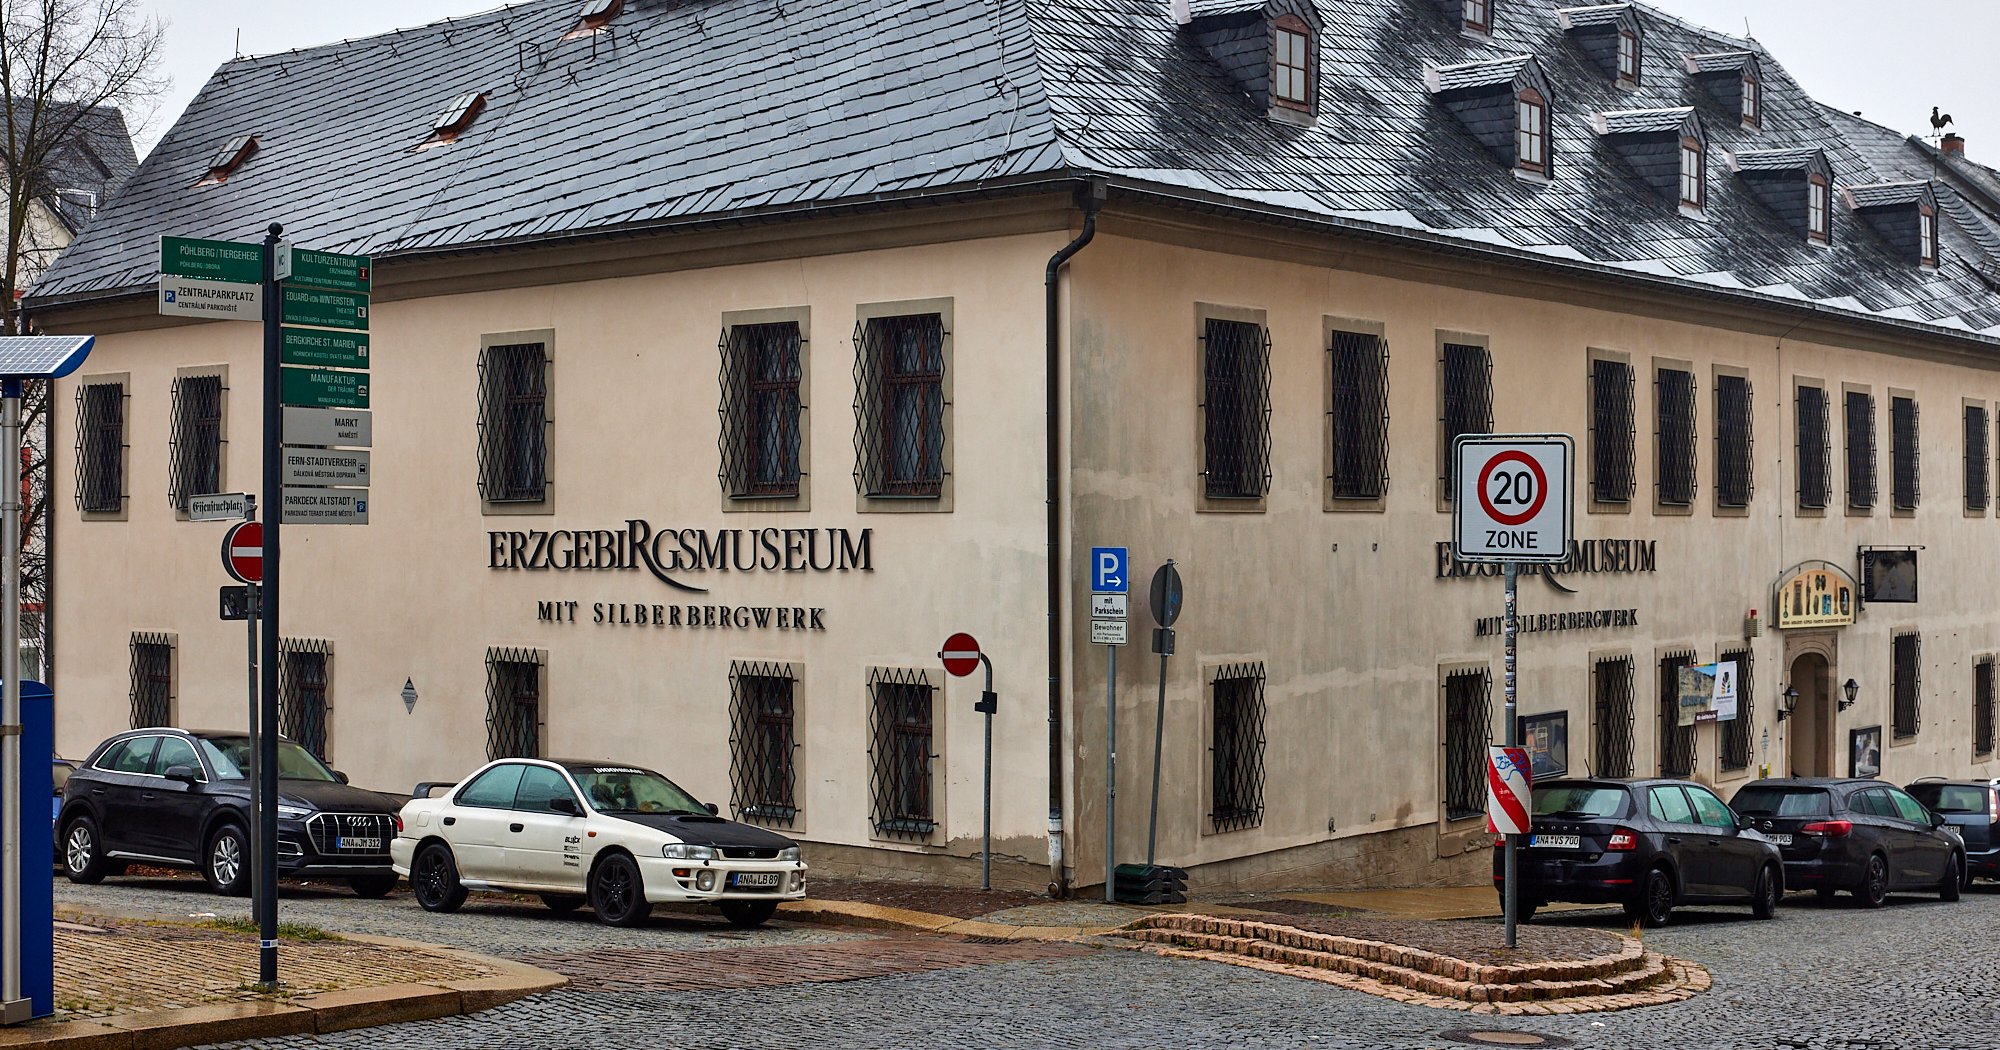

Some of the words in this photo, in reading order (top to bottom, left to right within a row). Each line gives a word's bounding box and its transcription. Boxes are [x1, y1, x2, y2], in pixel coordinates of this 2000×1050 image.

[180, 244, 215, 258] PÖHLBERG
[219, 248, 259, 260] TIERGEHEGE
[301, 254, 357, 268] KULTURZENTRUM
[178, 286, 254, 301] ZENTRALPARKPLATZ
[286, 292, 308, 302] EDUARD
[319, 296, 355, 306] WINTERSTEIN
[286, 335, 321, 346] BERGKIRCHE
[322, 338, 332, 347] ST.
[333, 339, 355, 349] MARIEN
[310, 374, 355, 385] MANUFAKTUR
[334, 418, 358, 427] MARKT
[288, 456, 357, 467] FERN-STADTVERKEHR
[1493, 471, 1532, 505] 20
[285, 496, 318, 505] PARKDECK
[320, 496, 350, 505] ALTSTADT
[1485, 531, 1538, 549] ZONE
[487, 519, 874, 592] ERZGEBIRGSMUSEUM
[1100, 553, 1119, 586] P
[537, 600, 578, 622] MIT
[593, 602, 826, 630] SILBERBERGWERK
[1095, 606, 1124, 615] Parkschein
[1476, 616, 1505, 637] MIT
[1515, 608, 1638, 633] SILBERBERGWERK
[342, 838, 354, 847] ANA
[368, 839, 380, 847] 312
[1536, 836, 1549, 844] ANA
[1554, 836, 1564, 844] VS
[1565, 837, 1578, 845] 700
[1779, 835, 1792, 843] 903
[738, 875, 753, 884] ANA
[758, 875, 768, 884] LB
[769, 875, 778, 884] 89
